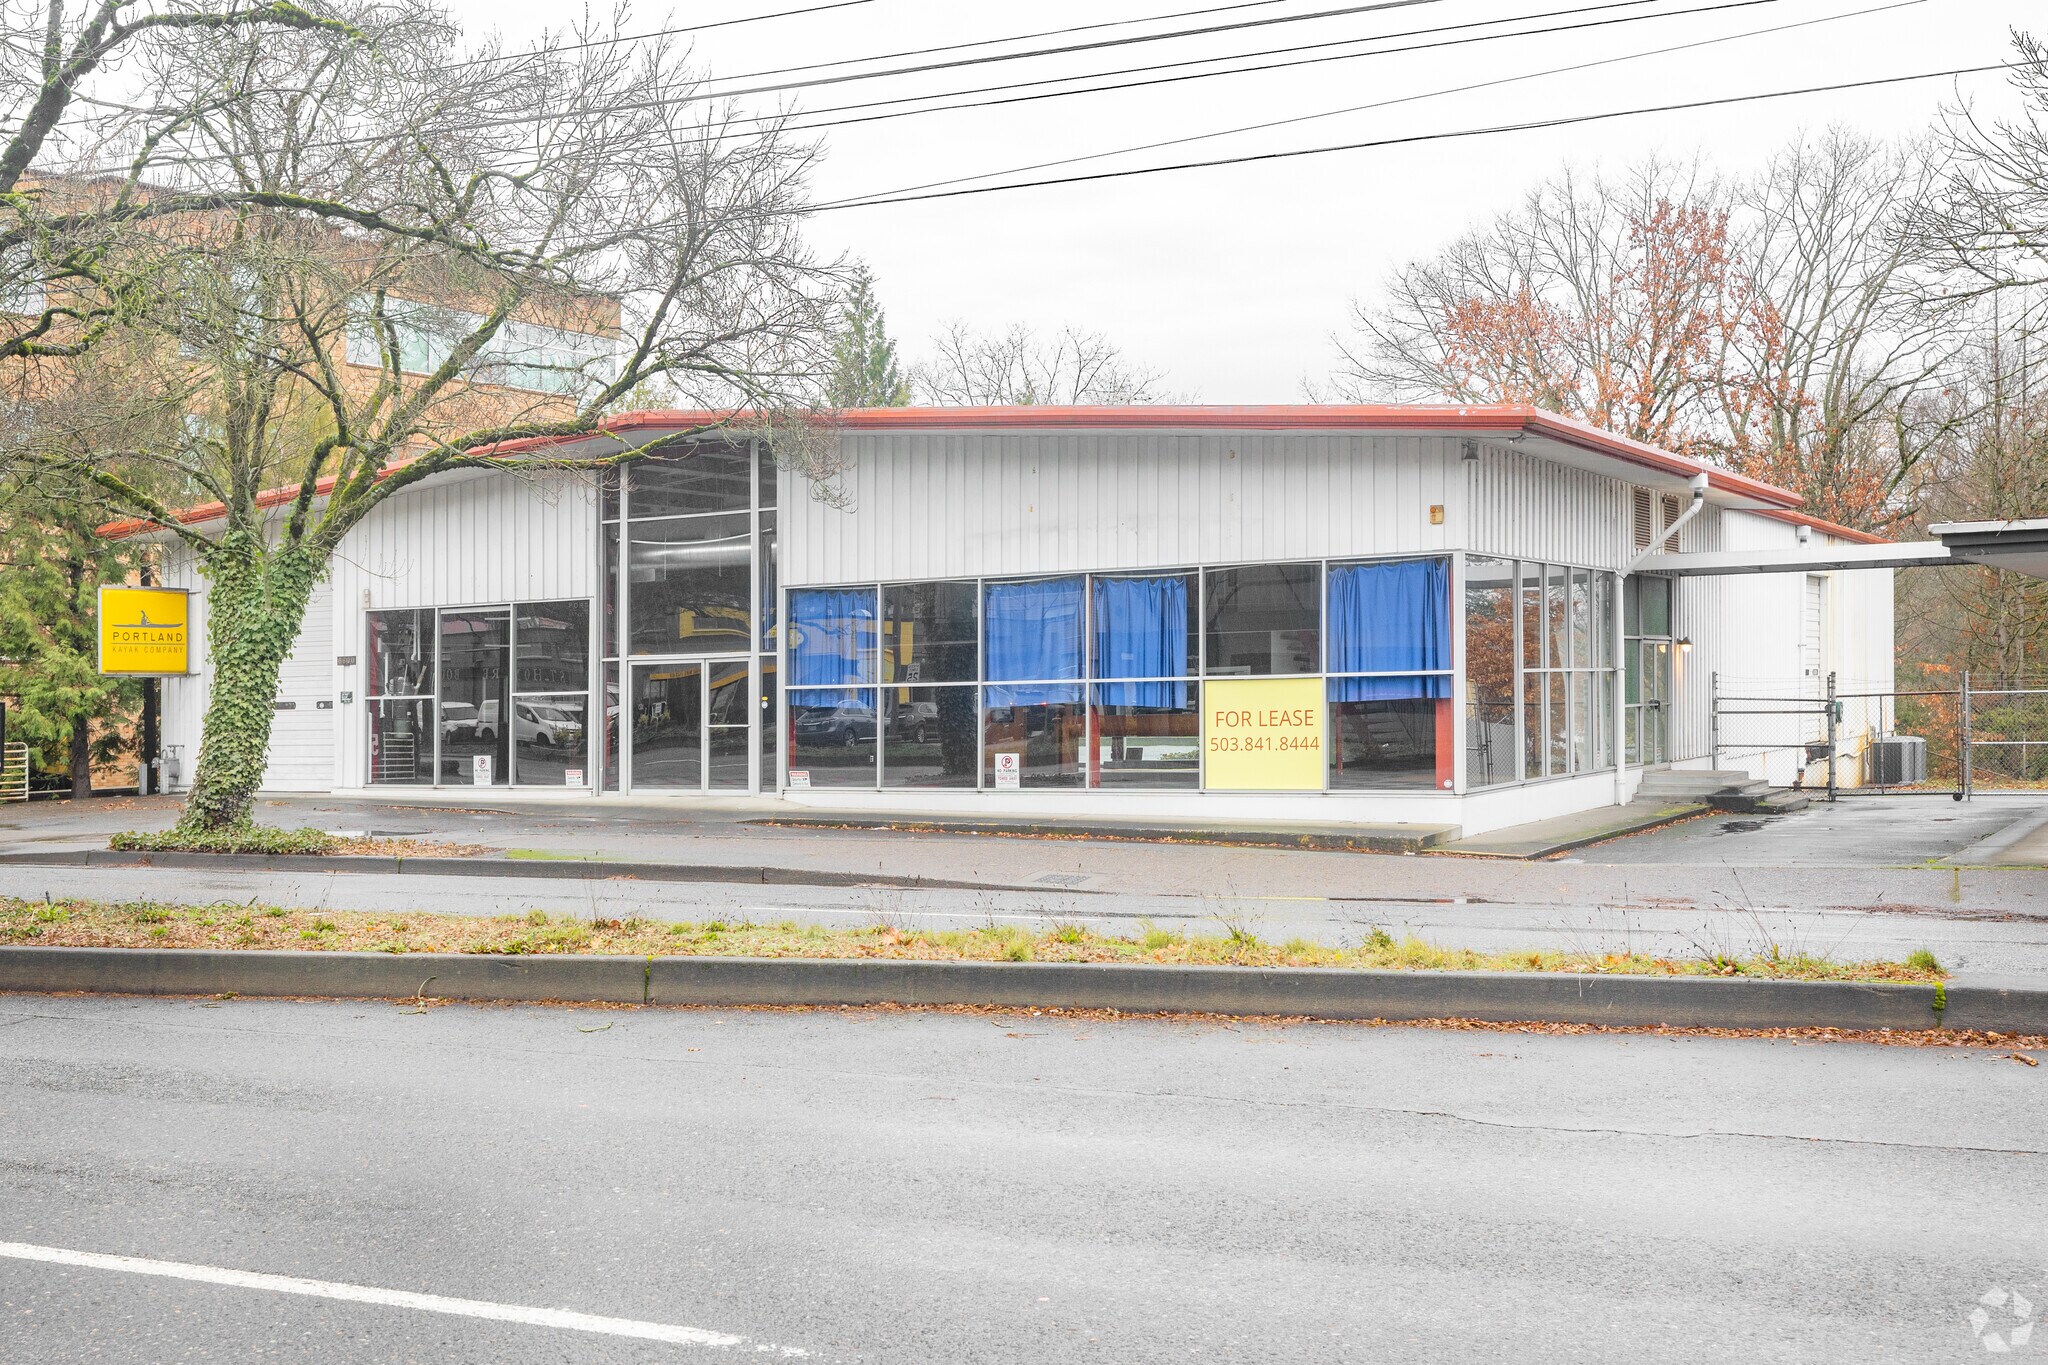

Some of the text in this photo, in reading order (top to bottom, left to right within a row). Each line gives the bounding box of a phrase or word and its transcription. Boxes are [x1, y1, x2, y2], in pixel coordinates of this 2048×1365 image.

[112, 632, 183, 642] PORTLAND
[1215, 709, 1314, 728] FOR LEASE
[1210, 736, 1320, 752] 503.841.8444
